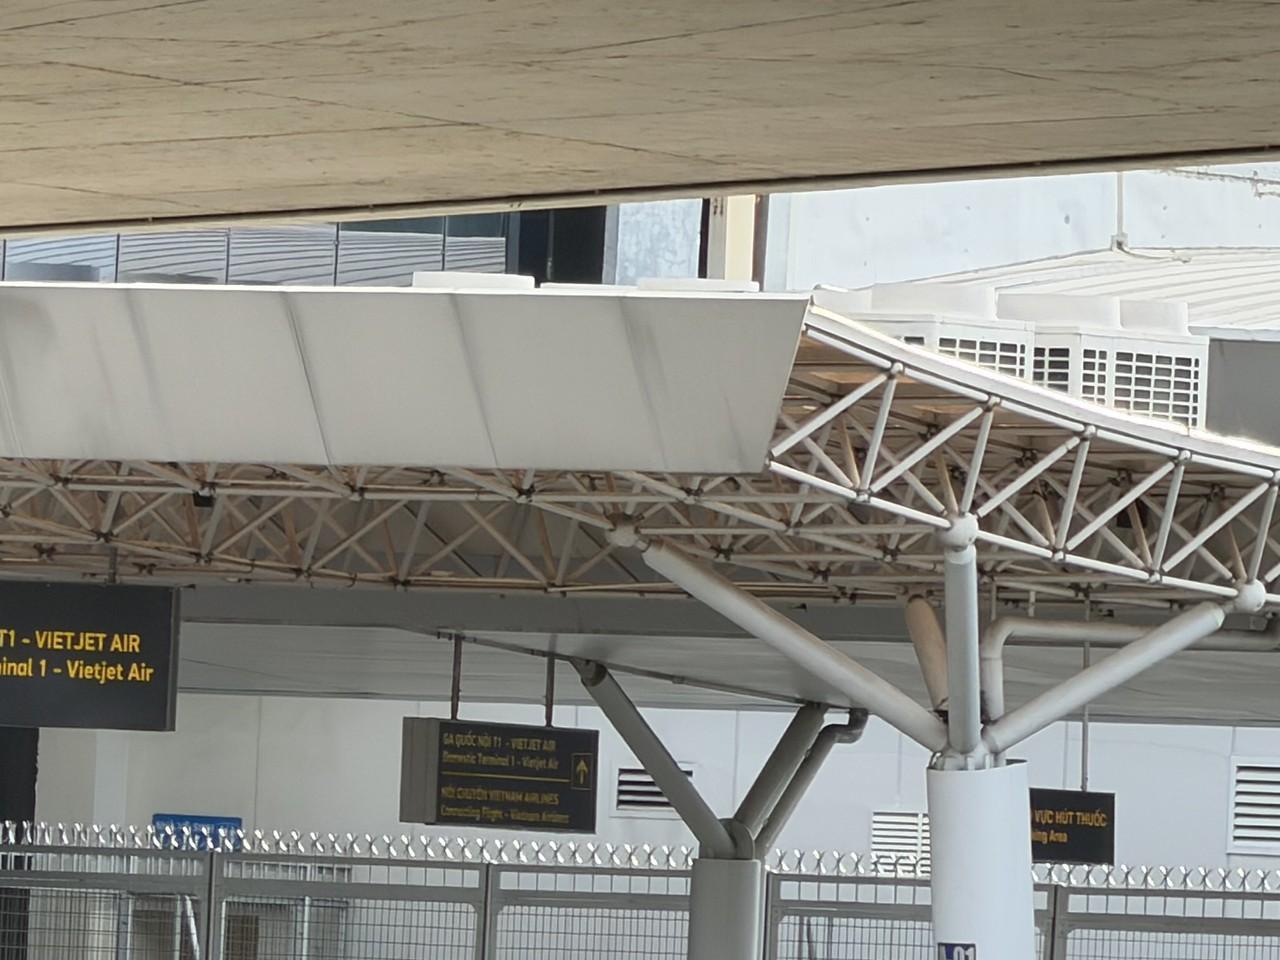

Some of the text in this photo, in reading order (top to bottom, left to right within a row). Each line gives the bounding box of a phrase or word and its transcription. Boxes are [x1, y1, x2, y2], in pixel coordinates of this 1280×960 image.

[35, 630, 107, 651] VIETJET
[110, 633, 141, 653] AIR
[39, 659, 47, 677] 1
[66, 659, 124, 684] Vietjet
[127, 662, 155, 682] Air
